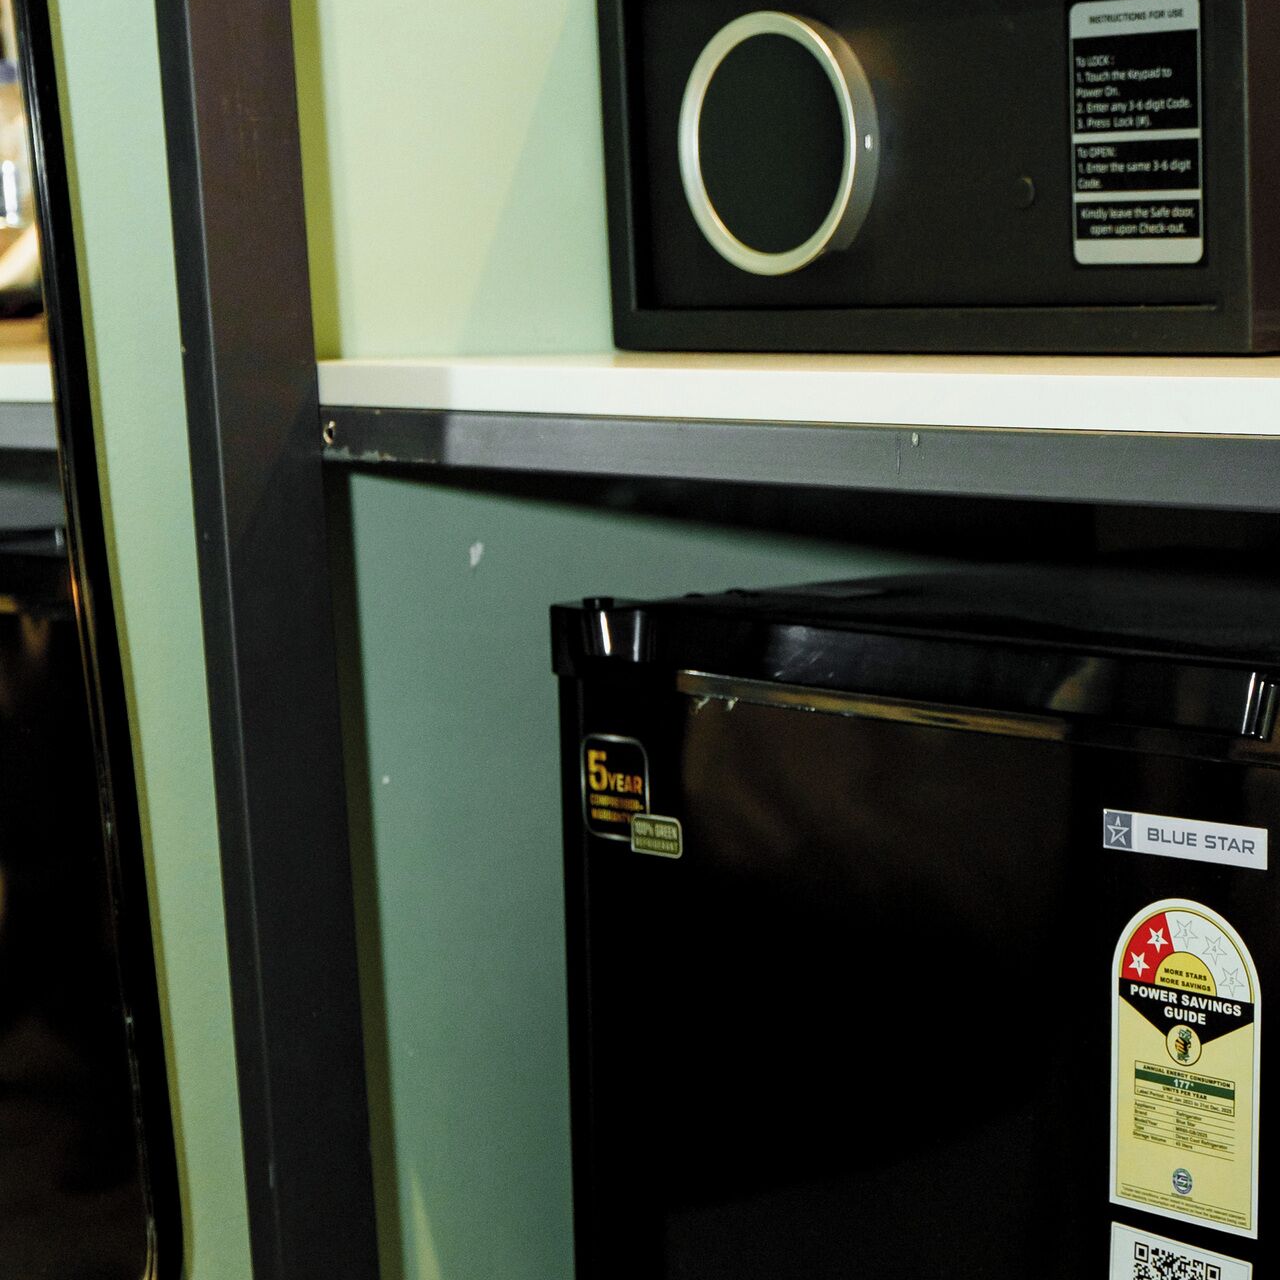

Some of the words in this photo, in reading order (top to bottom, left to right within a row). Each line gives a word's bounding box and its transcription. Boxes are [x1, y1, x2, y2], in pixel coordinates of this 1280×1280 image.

[1089, 12, 1146, 24] INSTRUCTIONS
[1149, 10, 1165, 20] FOR
[1167, 8, 1183, 18] USE
[1076, 56, 1086, 67] To
[1085, 71, 1110, 82] Touch
[1111, 70, 1126, 81] the
[1127, 68, 1160, 81] Keypad
[1161, 68, 1172, 78] to
[1076, 87, 1103, 98] Power
[1076, 103, 1084, 114] 2.
[1086, 102, 1109, 113] Enter
[1110, 102, 1127, 113] any
[1129, 100, 1144, 111] 3-6
[1145, 99, 1165, 112] digit
[1077, 118, 1084, 129] 3.
[1086, 117, 1111, 129] Press
[1113, 117, 1133, 128] Lock
[1078, 147, 1088, 158] To
[1086, 162, 1109, 173] Enter
[1110, 162, 1125, 173] the
[1126, 162, 1151, 172] same
[1153, 160, 1169, 171] 3-6
[1170, 159, 1191, 173] digit
[1081, 208, 1108, 221] Kindly
[1109, 208, 1133, 219] leave
[1134, 208, 1149, 218] the
[1150, 207, 1170, 218] Safe
[1090, 225, 1113, 236] open
[1114, 225, 1138, 235] upon
[588, 749, 608, 791] 5
[608, 772, 643, 795] YEAR
[655, 823, 678, 840] GREEN
[1147, 827, 1197, 847] BLUE
[1205, 834, 1256, 855] STAR
[1154, 934, 1160, 943] 2
[1164, 967, 1183, 977] MORE
[1185, 971, 1207, 981] STARS
[1160, 976, 1179, 986] MORE
[1181, 980, 1211, 991] SAVINGS
[1130, 984, 1177, 1004] POWER
[1181, 995, 1242, 1017] SAVINGS
[1164, 1006, 1206, 1025] GUIDE
[1143, 1065, 1165, 1074] ANNUAL
[1166, 1069, 1188, 1079] ENERGY
[1190, 1075, 1231, 1088] CONSUMPTION
[1162, 1086, 1179, 1094] UNITS
[1192, 1092, 1207, 1100] YEAR
